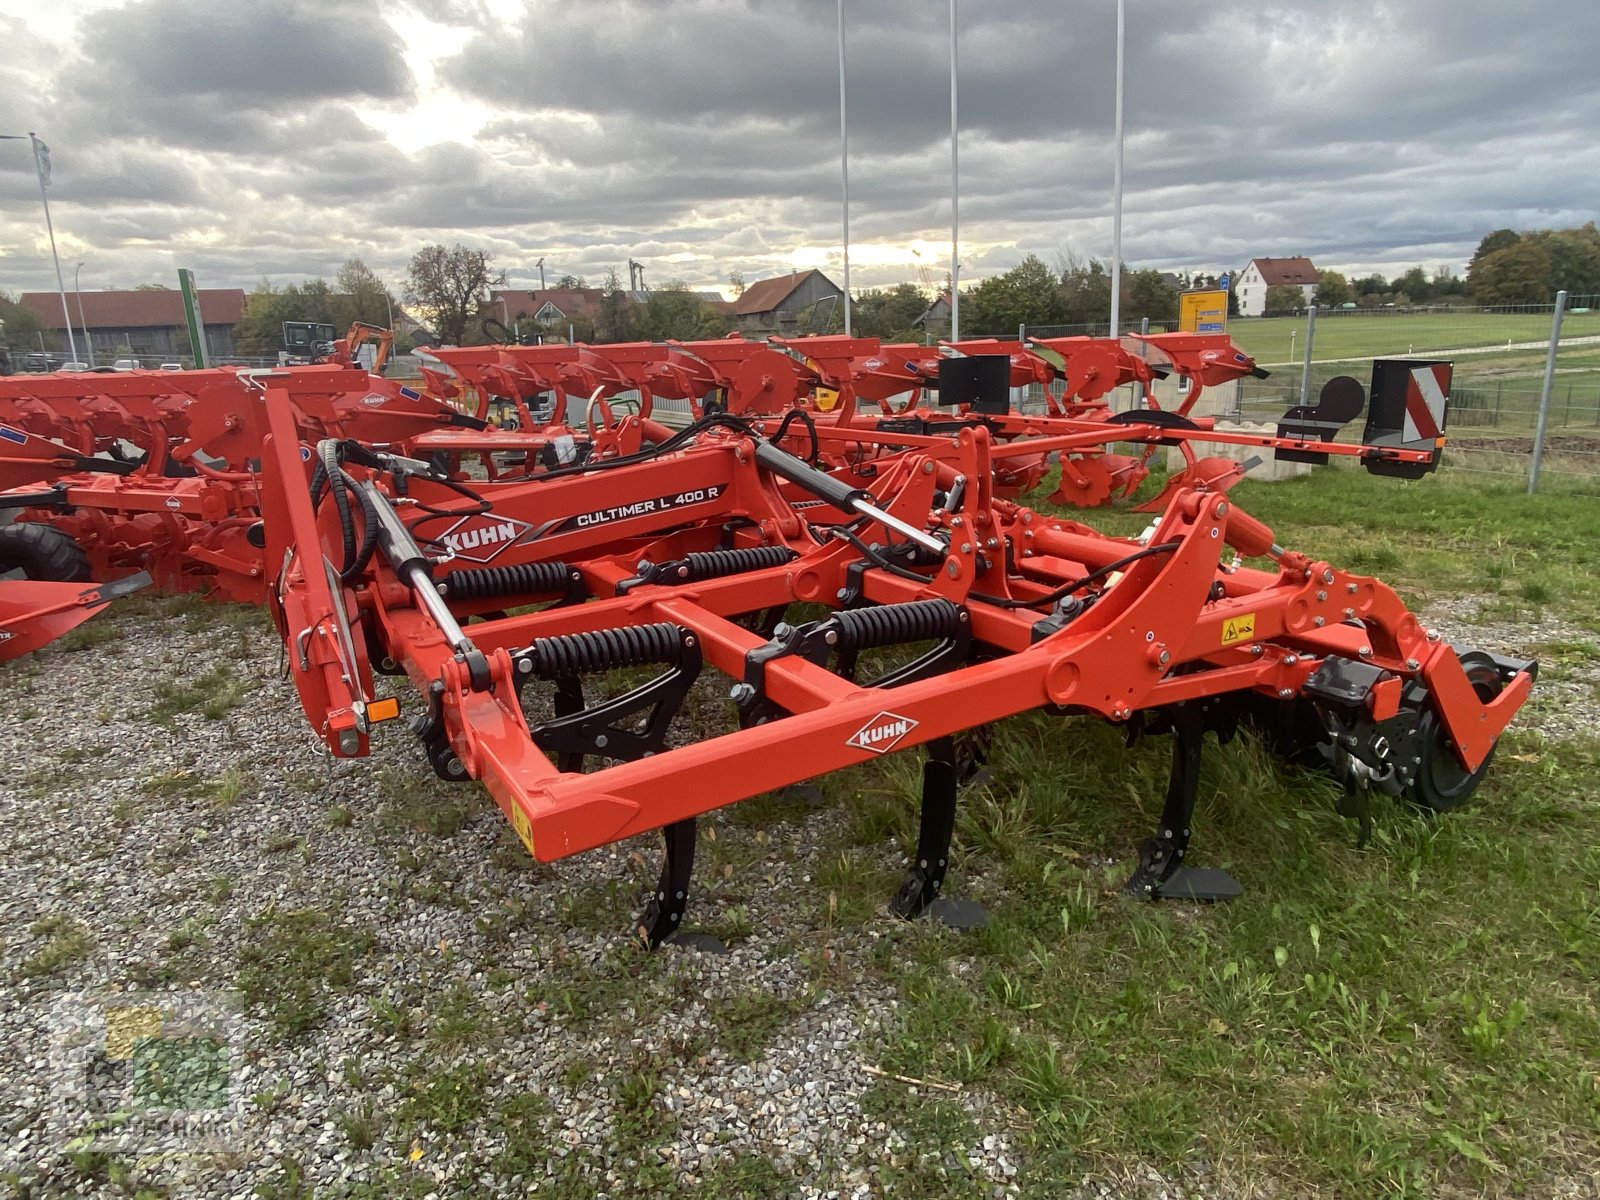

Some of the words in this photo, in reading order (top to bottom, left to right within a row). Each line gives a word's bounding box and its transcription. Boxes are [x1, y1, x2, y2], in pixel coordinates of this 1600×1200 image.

[577, 500, 657, 527] CULTIMER
[660, 498, 671, 509] L
[674, 490, 705, 505] 400
[708, 487, 720, 499] R
[443, 522, 517, 553] KUHN
[859, 720, 907, 746] KUHN
